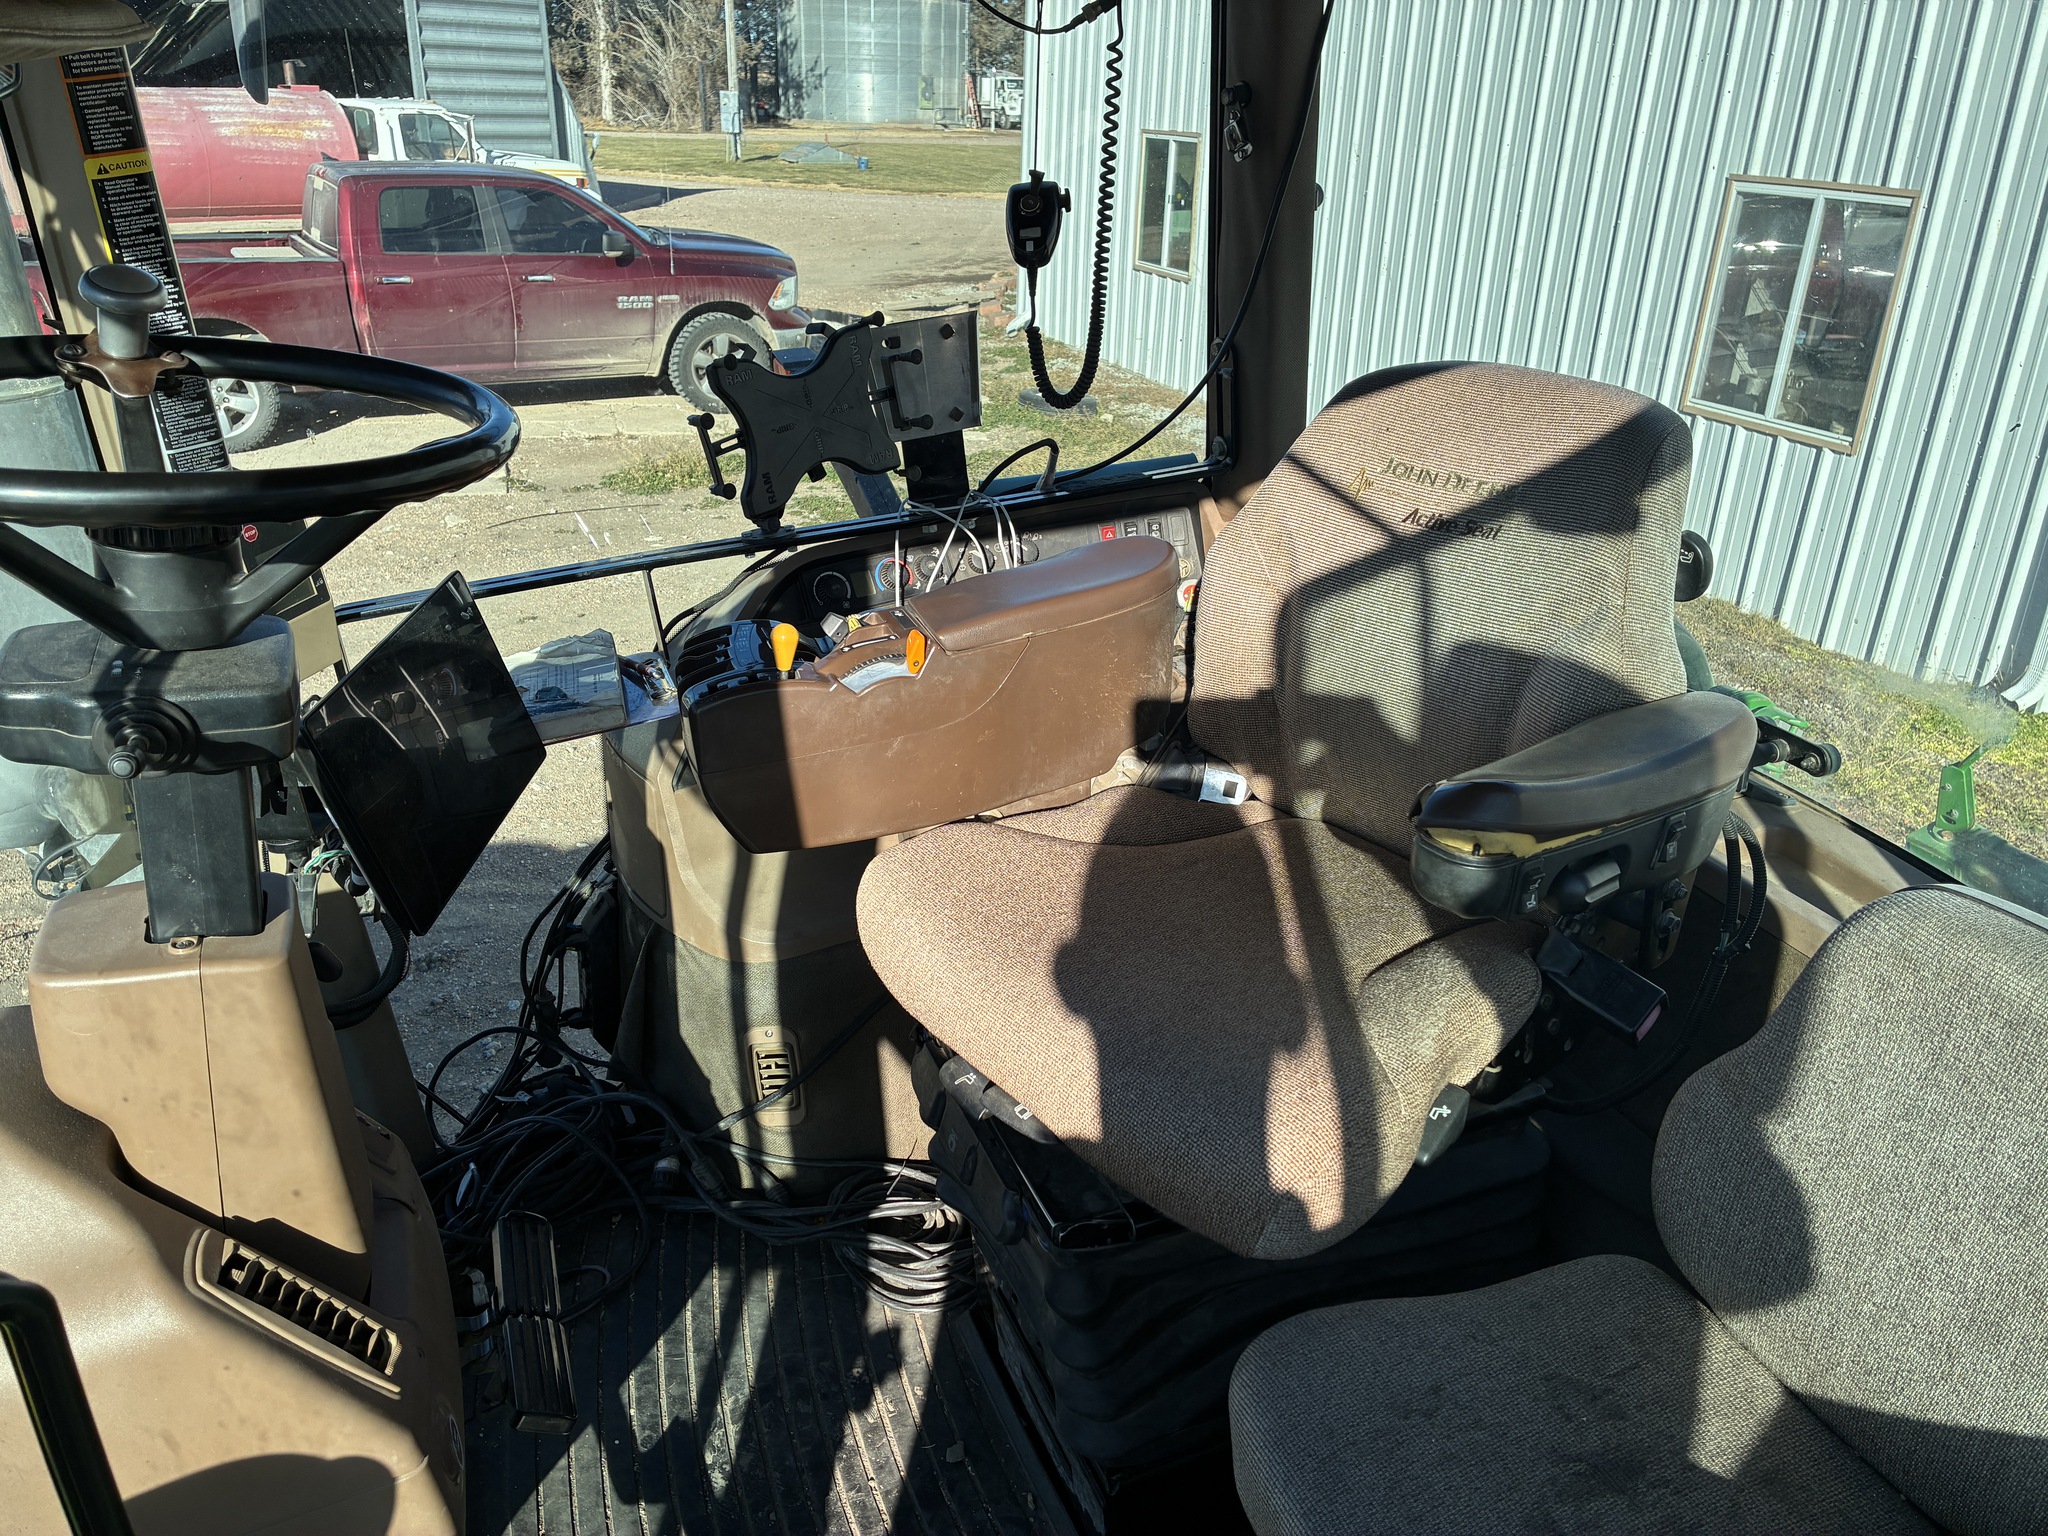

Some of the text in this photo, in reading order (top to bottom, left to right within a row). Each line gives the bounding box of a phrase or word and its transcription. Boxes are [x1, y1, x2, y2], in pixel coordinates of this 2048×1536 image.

[108, 160, 147, 171] CAUTION
[850, 335, 862, 368] RAM
[724, 369, 753, 386] RAM
[869, 448, 894, 465] RAM
[762, 472, 776, 505] RAM
[1379, 455, 1523, 500] JOHN DEERE
[244, 530, 256, 538] STOP
[1402, 508, 1502, 540] Active Seat
